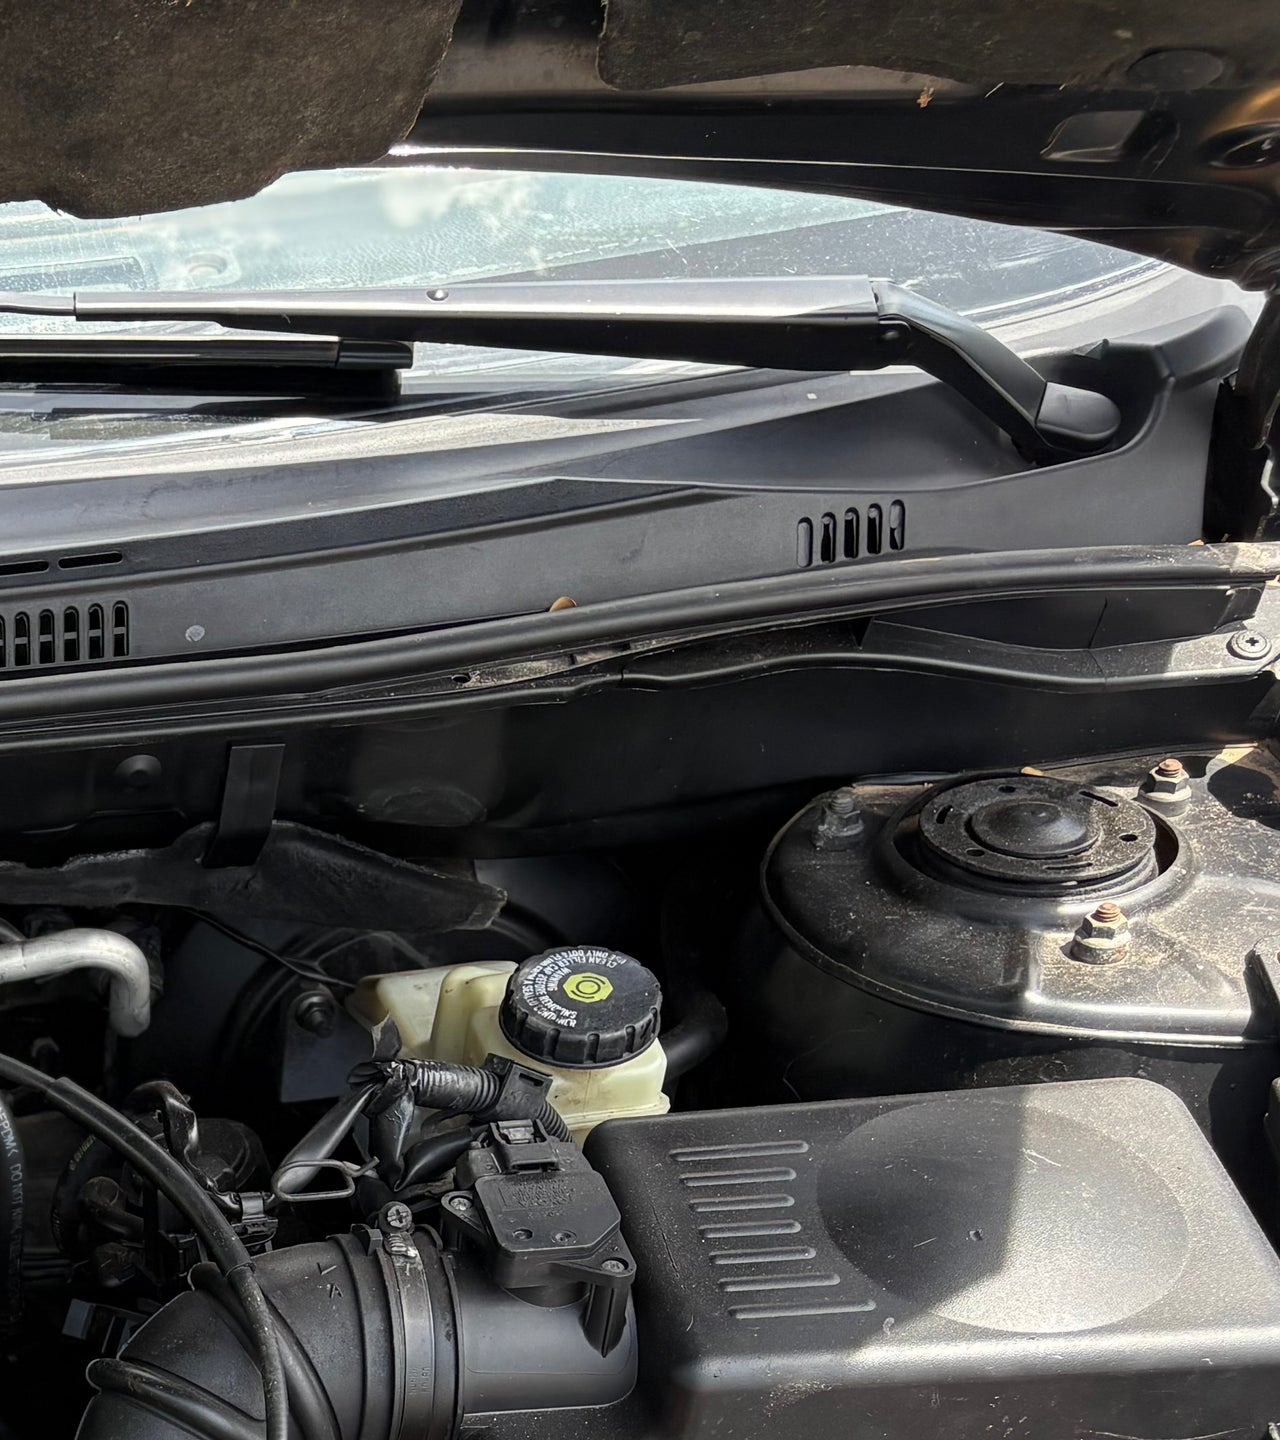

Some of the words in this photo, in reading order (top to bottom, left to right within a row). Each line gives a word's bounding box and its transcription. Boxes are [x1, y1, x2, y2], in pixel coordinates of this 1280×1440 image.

[561, 949, 584, 959] DOT4
[586, 950, 609, 958] ONLY
[557, 955, 586, 968] FILLER
[589, 957, 618, 968] CLEAN
[543, 963, 558, 975] CAP
[547, 967, 572, 991] WARNING
[10, 1163, 23, 1181] DO
